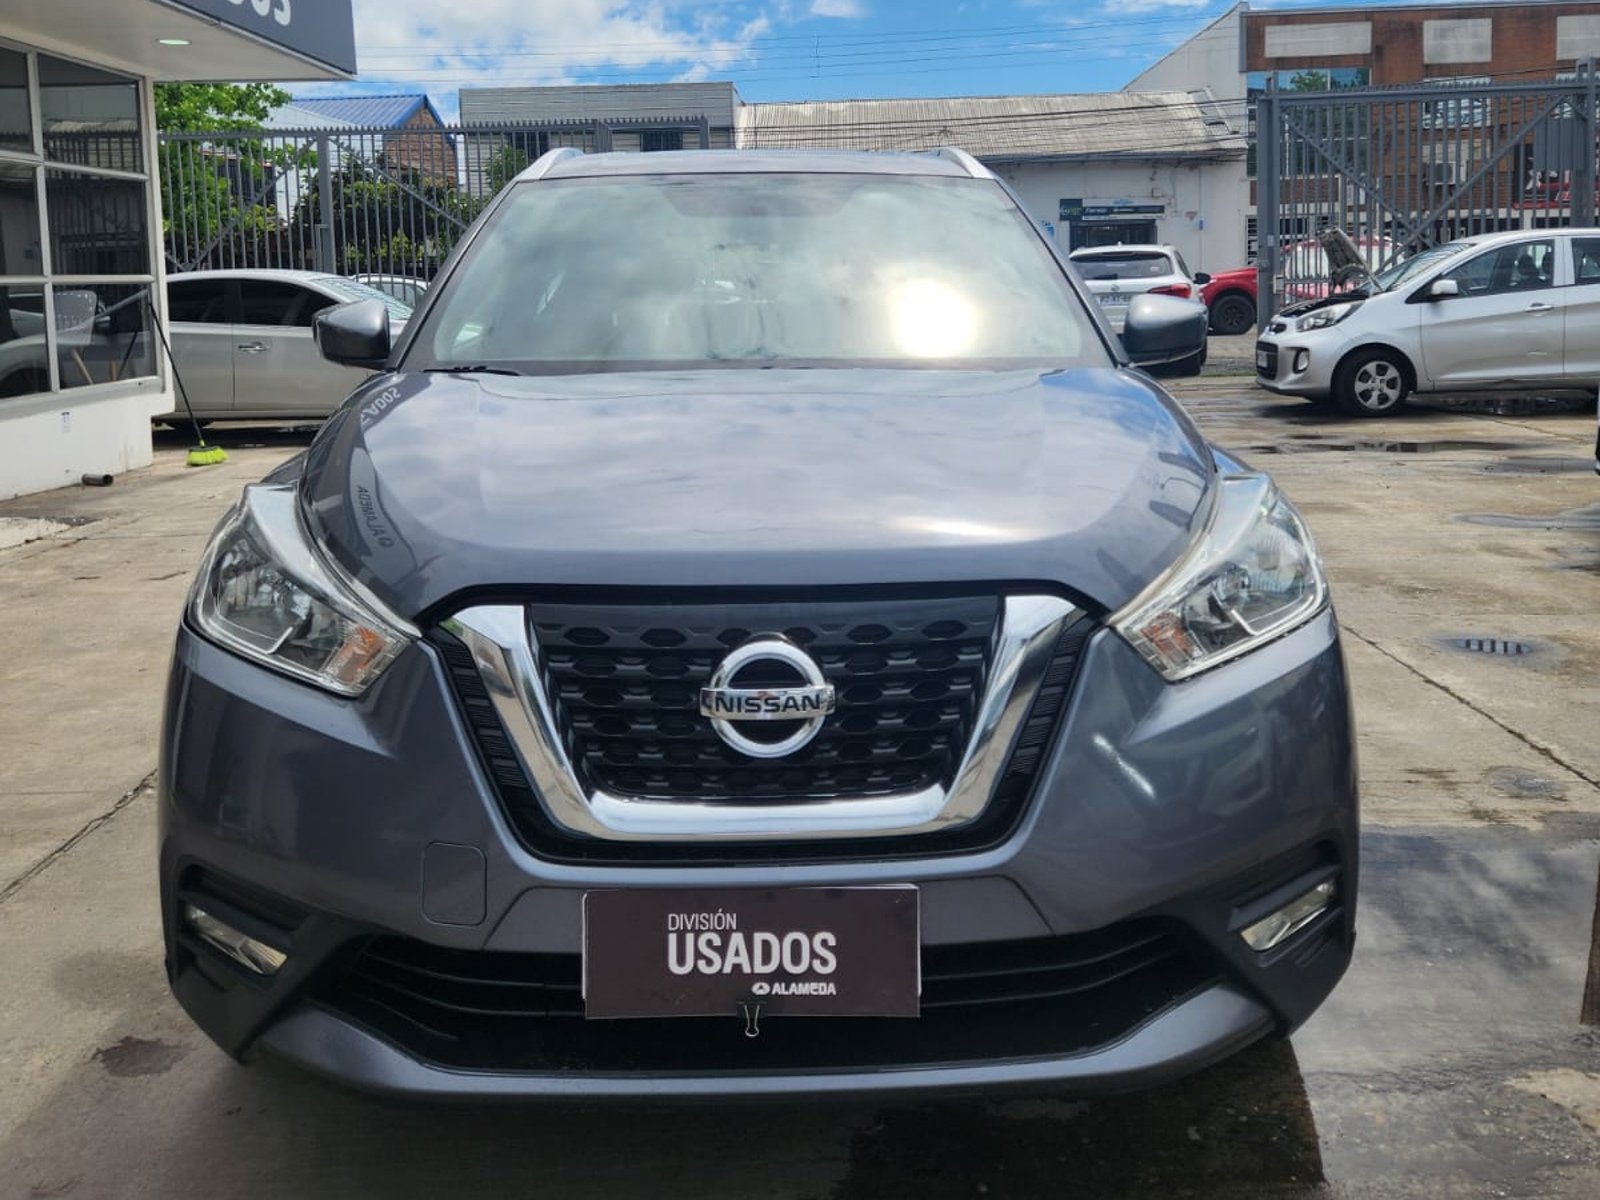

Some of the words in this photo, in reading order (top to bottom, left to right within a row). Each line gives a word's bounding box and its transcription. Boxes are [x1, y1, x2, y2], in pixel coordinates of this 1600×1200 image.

[715, 694, 820, 713] NISSAN
[667, 908, 737, 931] DIVISIÓN
[667, 932, 837, 975] USADOS
[771, 982, 837, 996] ALAMEDA
